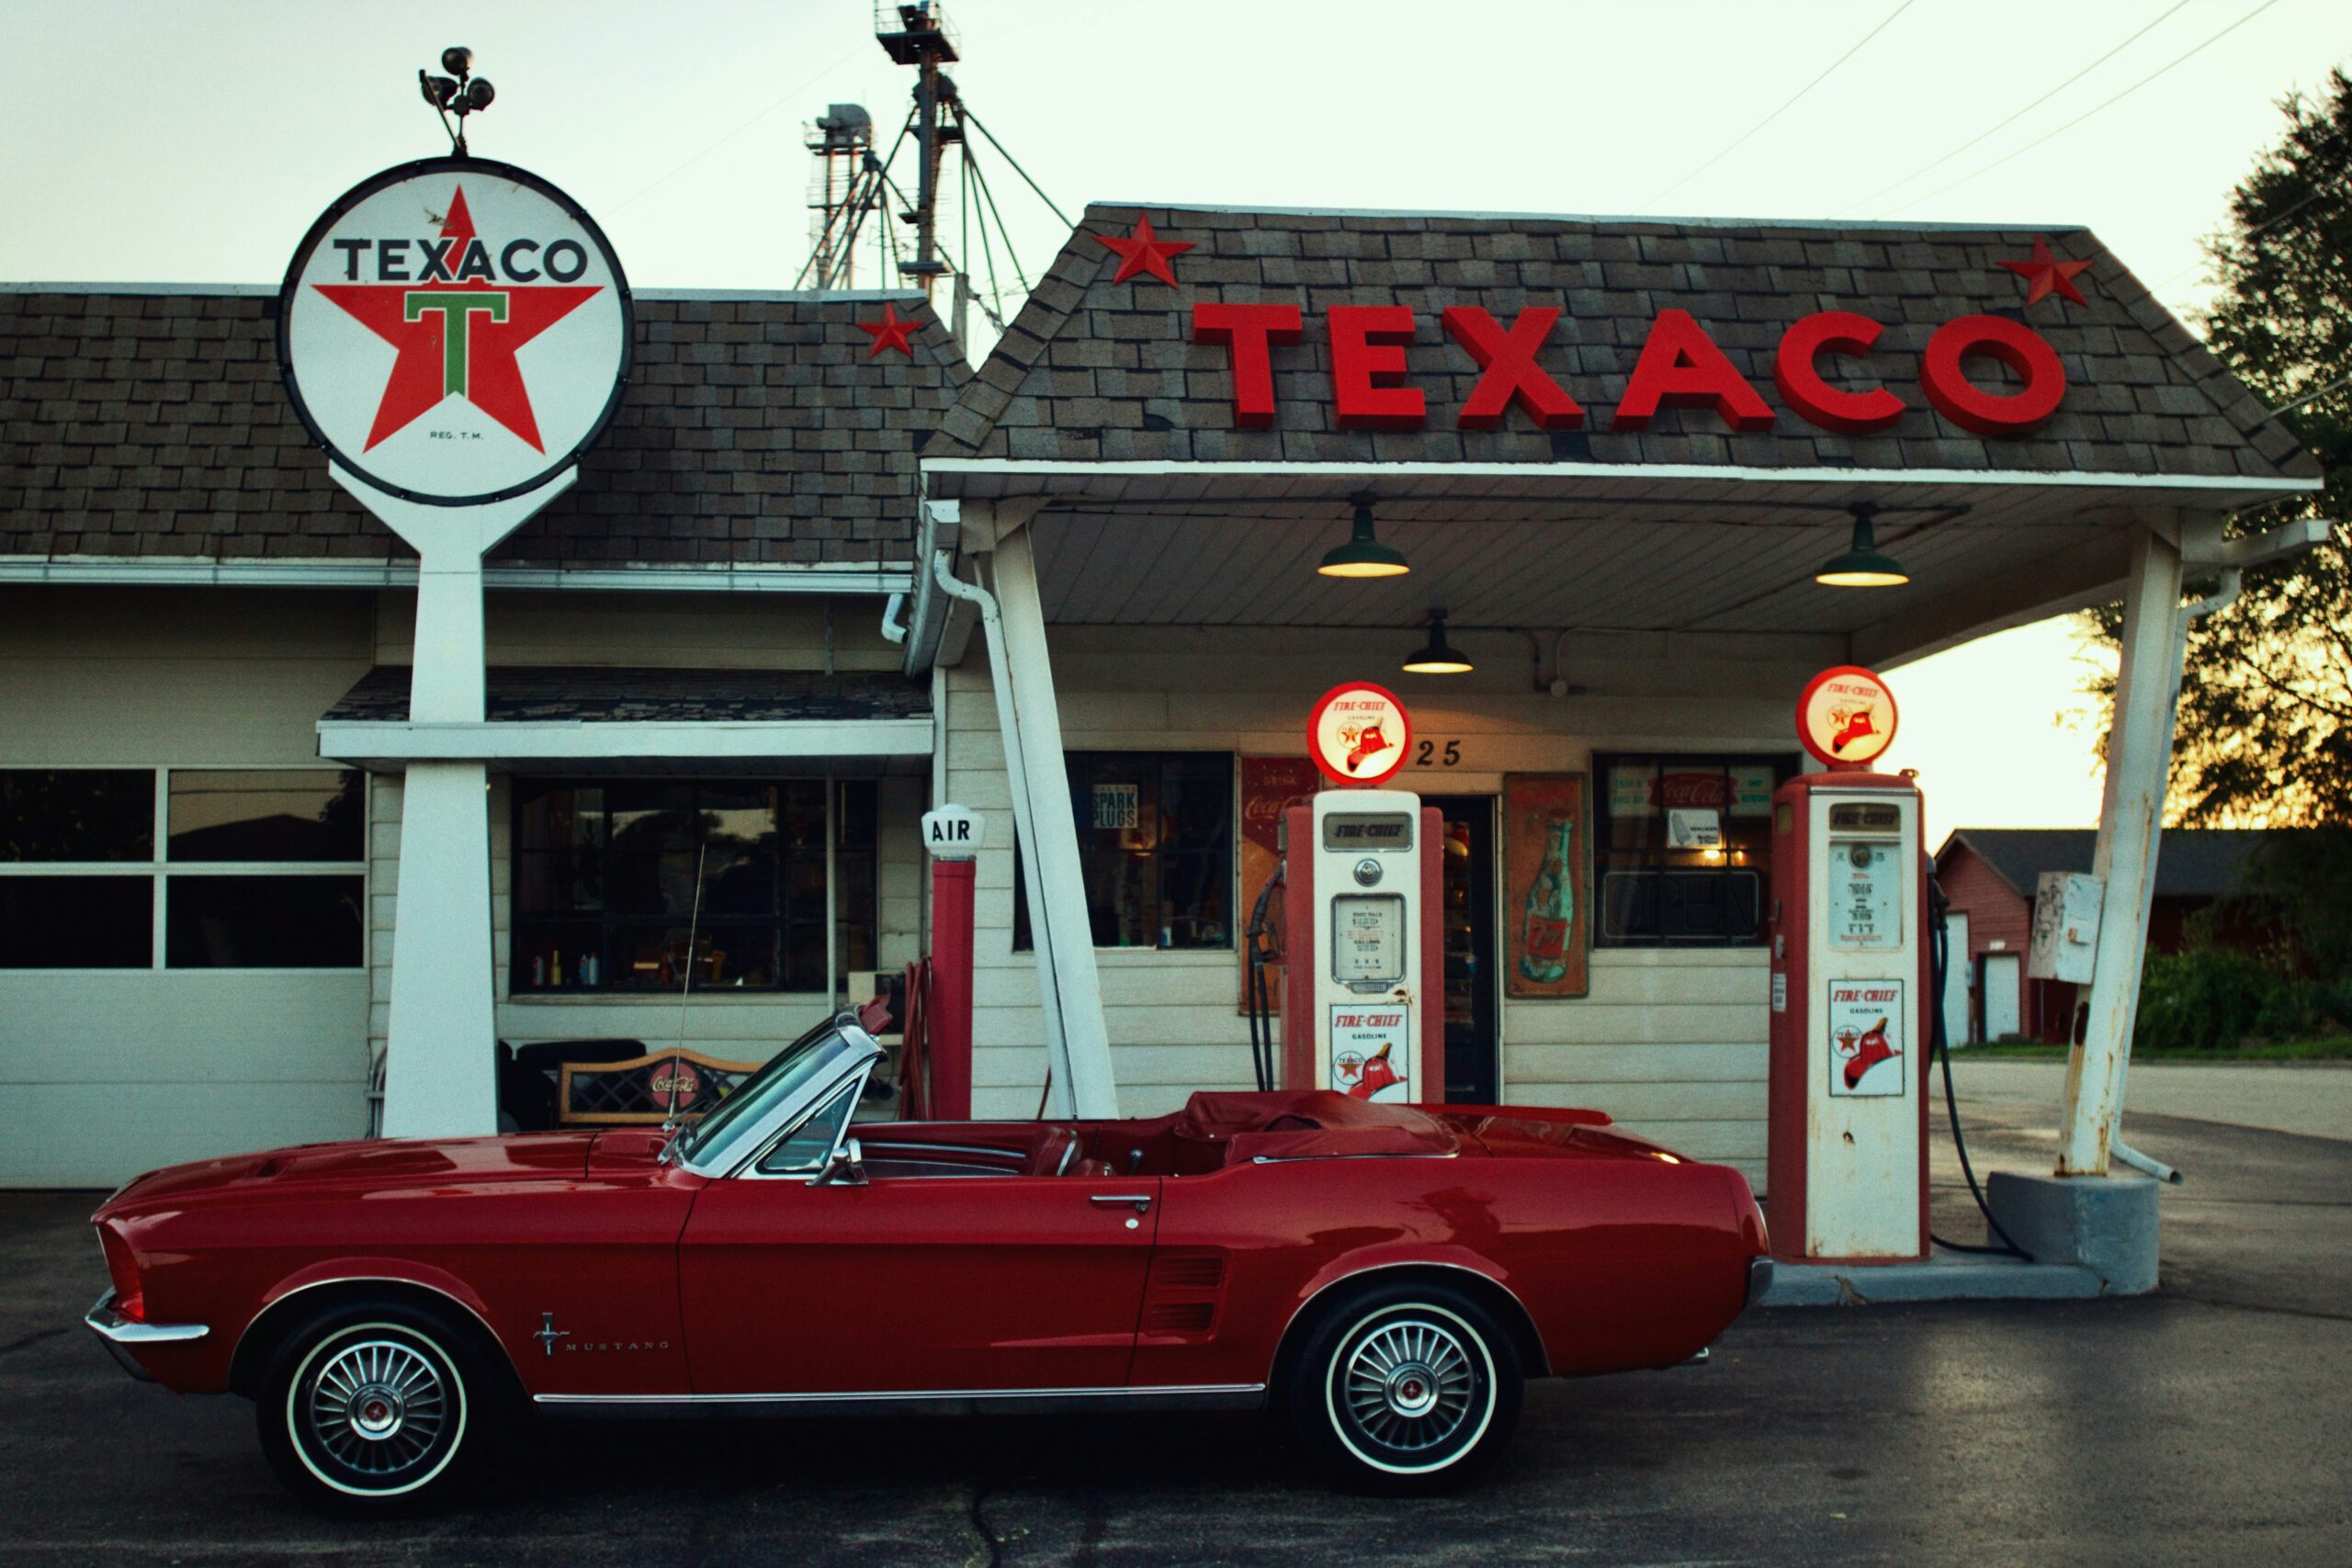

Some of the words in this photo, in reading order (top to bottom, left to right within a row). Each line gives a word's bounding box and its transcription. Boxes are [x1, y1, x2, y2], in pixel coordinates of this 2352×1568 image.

[334, 238, 588, 283] TEXACO
[1193, 302, 2066, 435] TEXACO
[429, 431, 456, 440] REG.
[1334, 701, 1385, 711] FIRE-CHIEF
[1092, 792, 1135, 809] SPARK
[933, 820, 969, 841] AIR
[1334, 824, 1404, 837] FIRE-CHIEF
[1833, 989, 1897, 1002] FIRE-CHIEF
[1335, 1014, 1403, 1028] FIRE-CHIEF
[566, 1341, 669, 1352] MUSTANG
